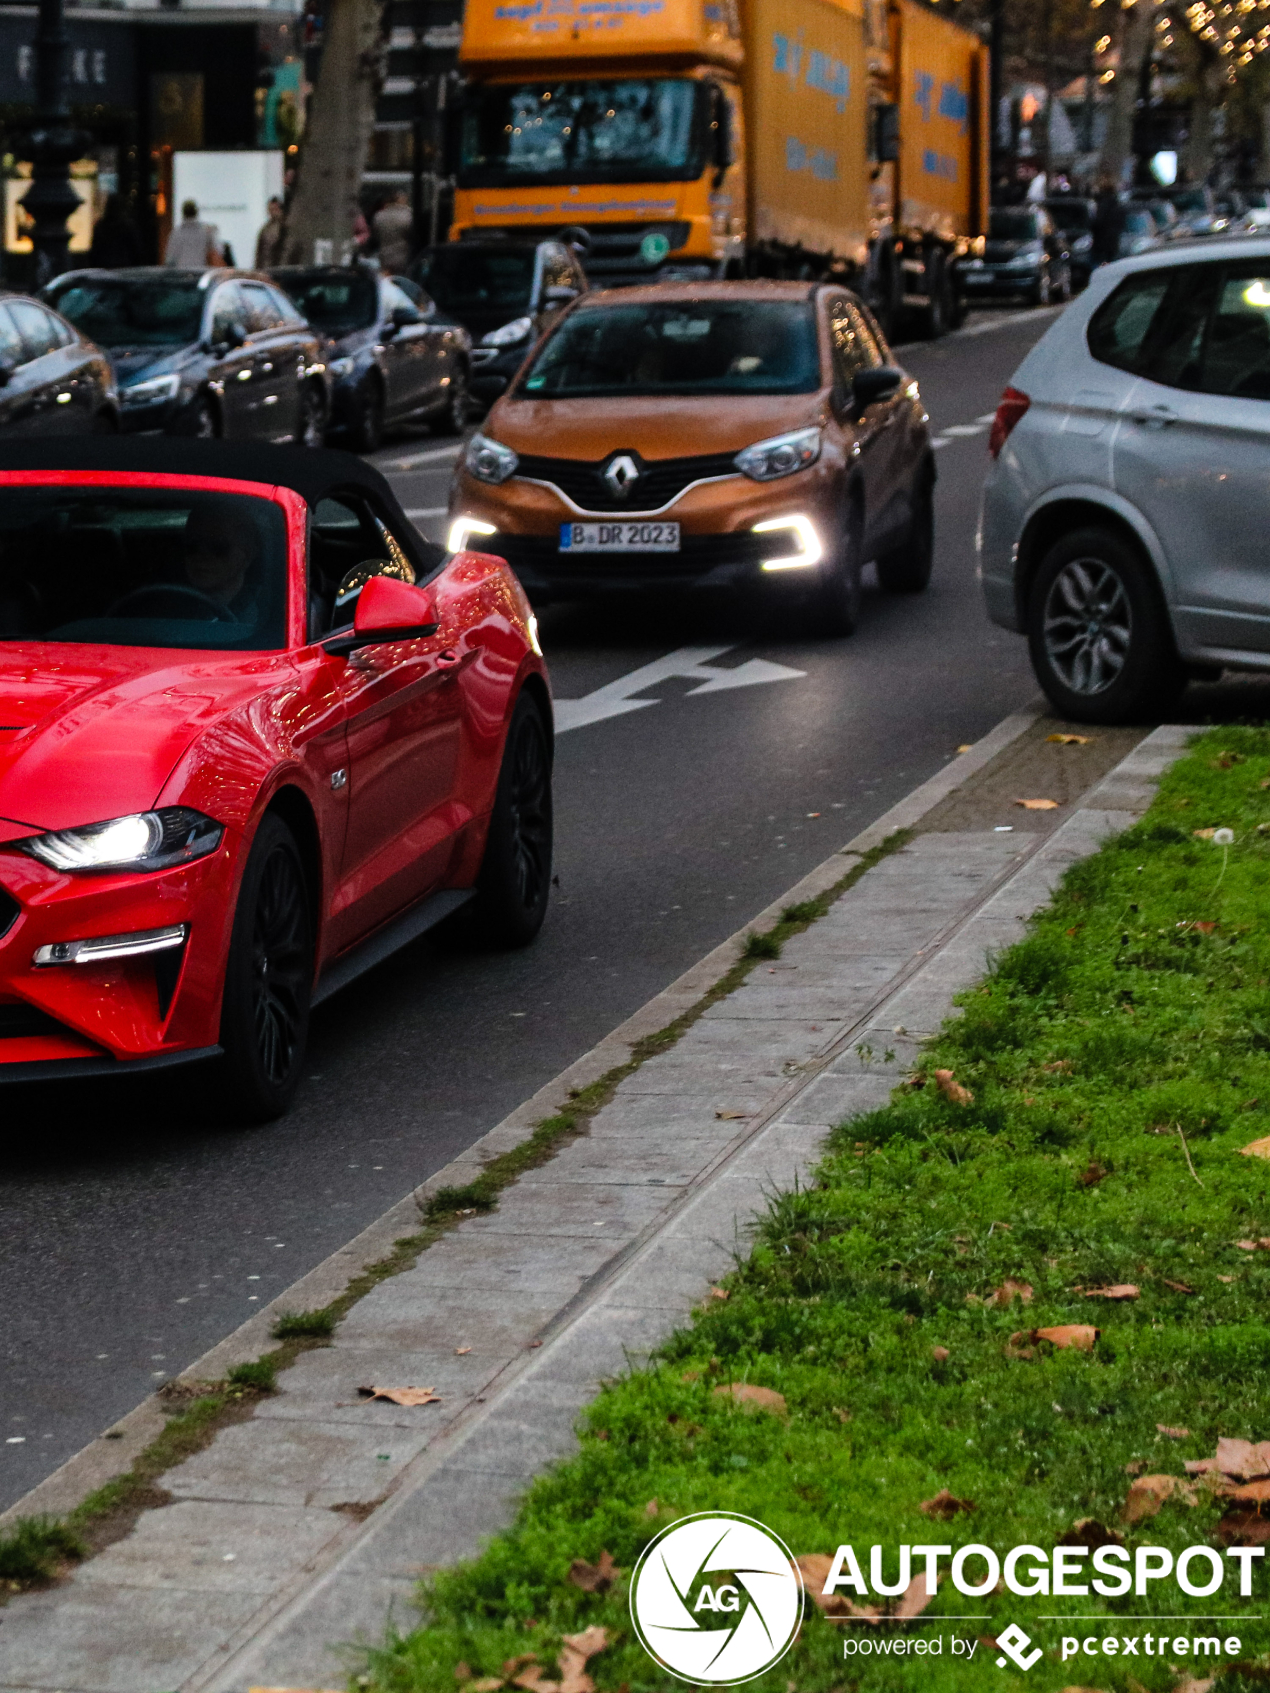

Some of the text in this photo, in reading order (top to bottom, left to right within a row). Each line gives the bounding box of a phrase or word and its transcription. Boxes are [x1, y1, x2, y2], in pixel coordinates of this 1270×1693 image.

[573, 525, 677, 544] B DR 2023
